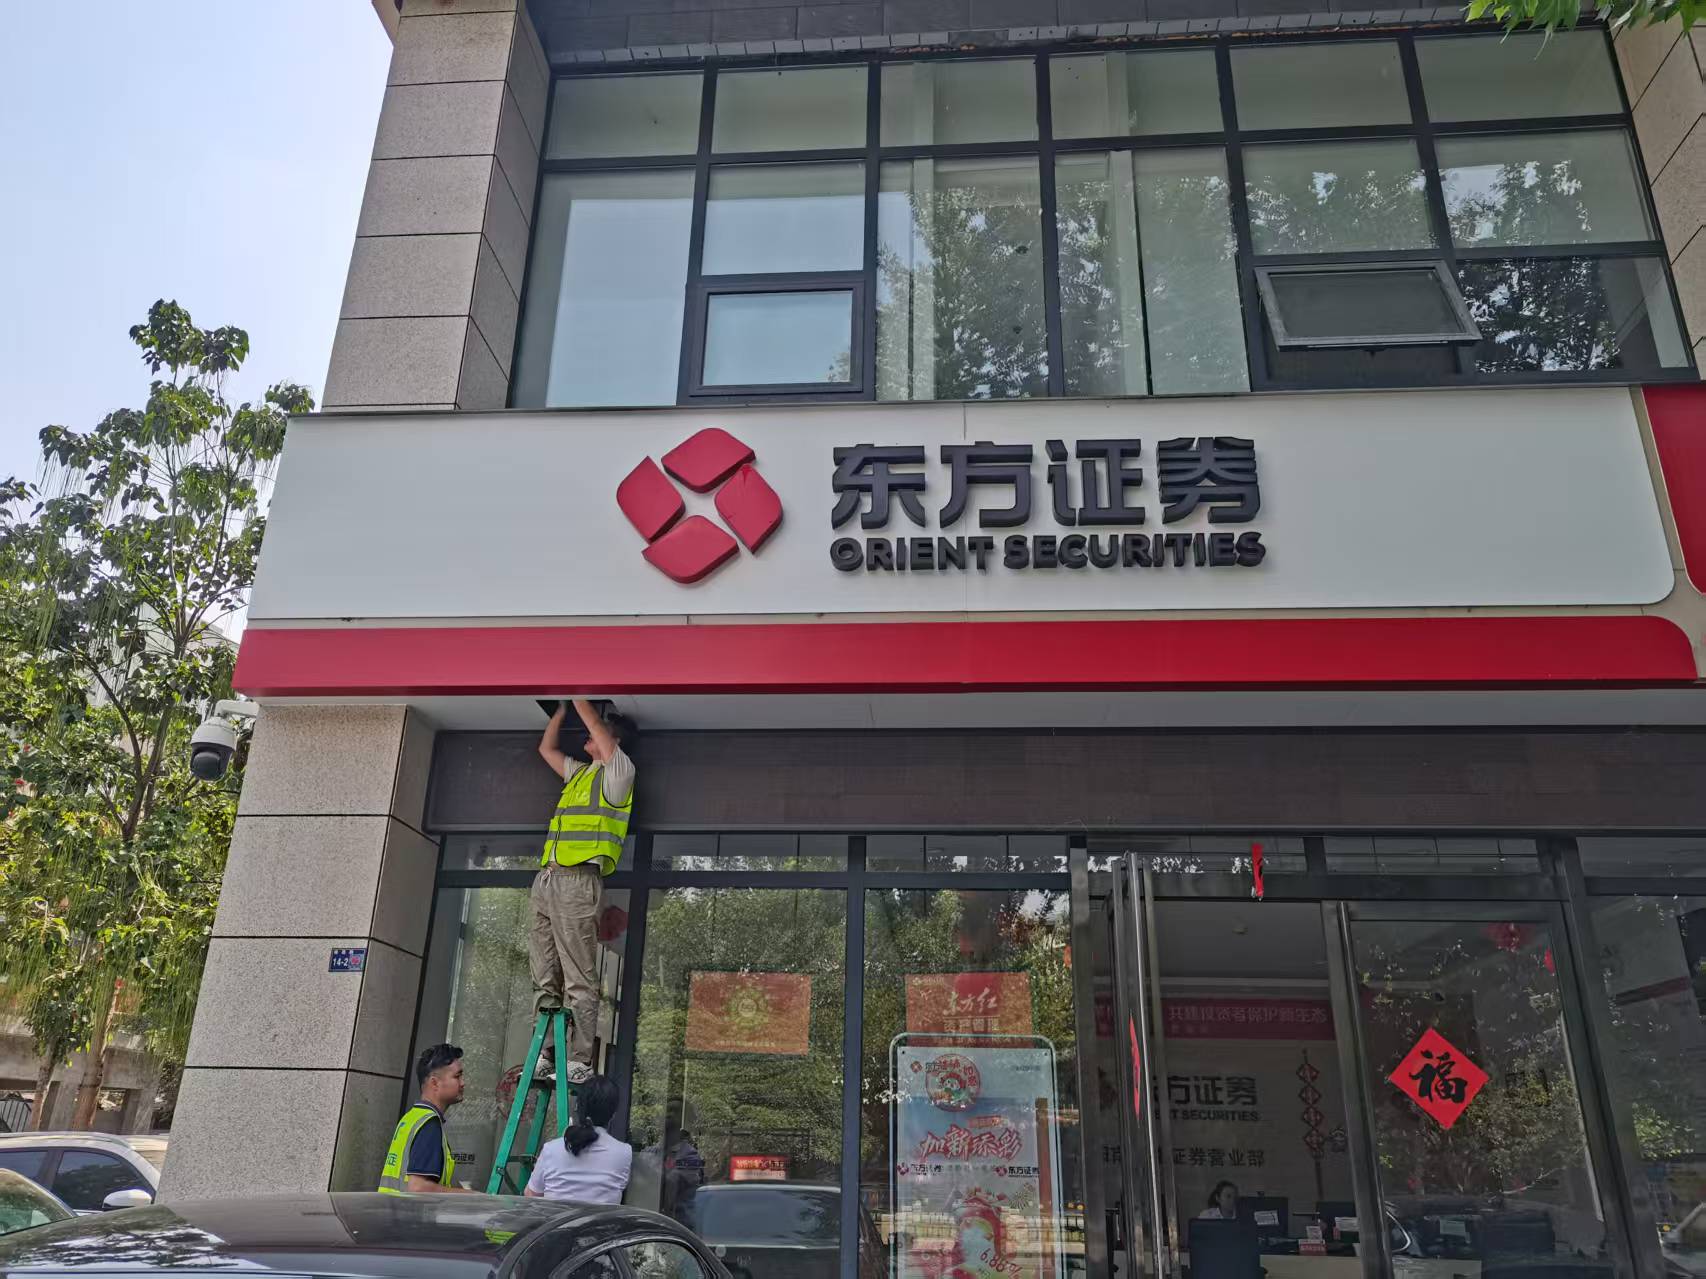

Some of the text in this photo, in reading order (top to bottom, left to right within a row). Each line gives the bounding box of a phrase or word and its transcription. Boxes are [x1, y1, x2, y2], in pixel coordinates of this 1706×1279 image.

[831, 437, 1260, 529] 东方证券
[830, 532, 1266, 571] ORIENT SECURITIES
[333, 957, 349, 967] 14-2
[943, 987, 998, 1016] 东方红
[1409, 1050, 1468, 1103] 福
